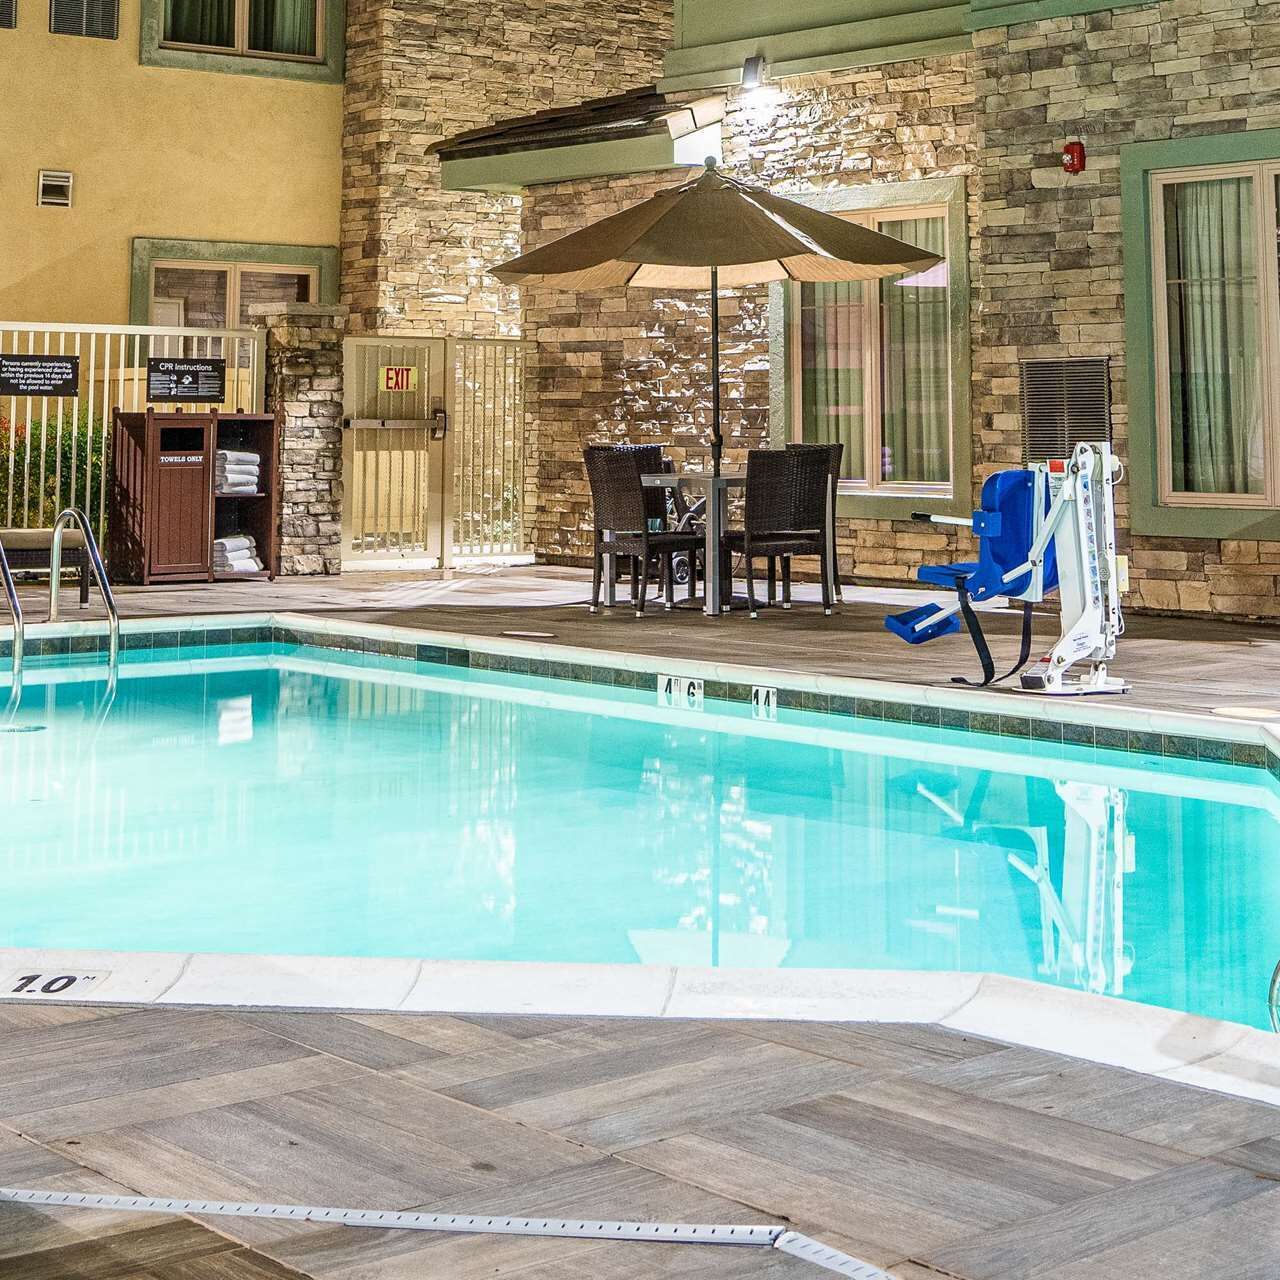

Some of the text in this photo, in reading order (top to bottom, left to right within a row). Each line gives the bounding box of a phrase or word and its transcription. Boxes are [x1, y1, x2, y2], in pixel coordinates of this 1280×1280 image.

[21, 360, 41, 368] currently
[159, 362, 212, 371] CPR Instructions
[386, 367, 412, 390] EXIT
[10, 974, 78, 994] 1.0
